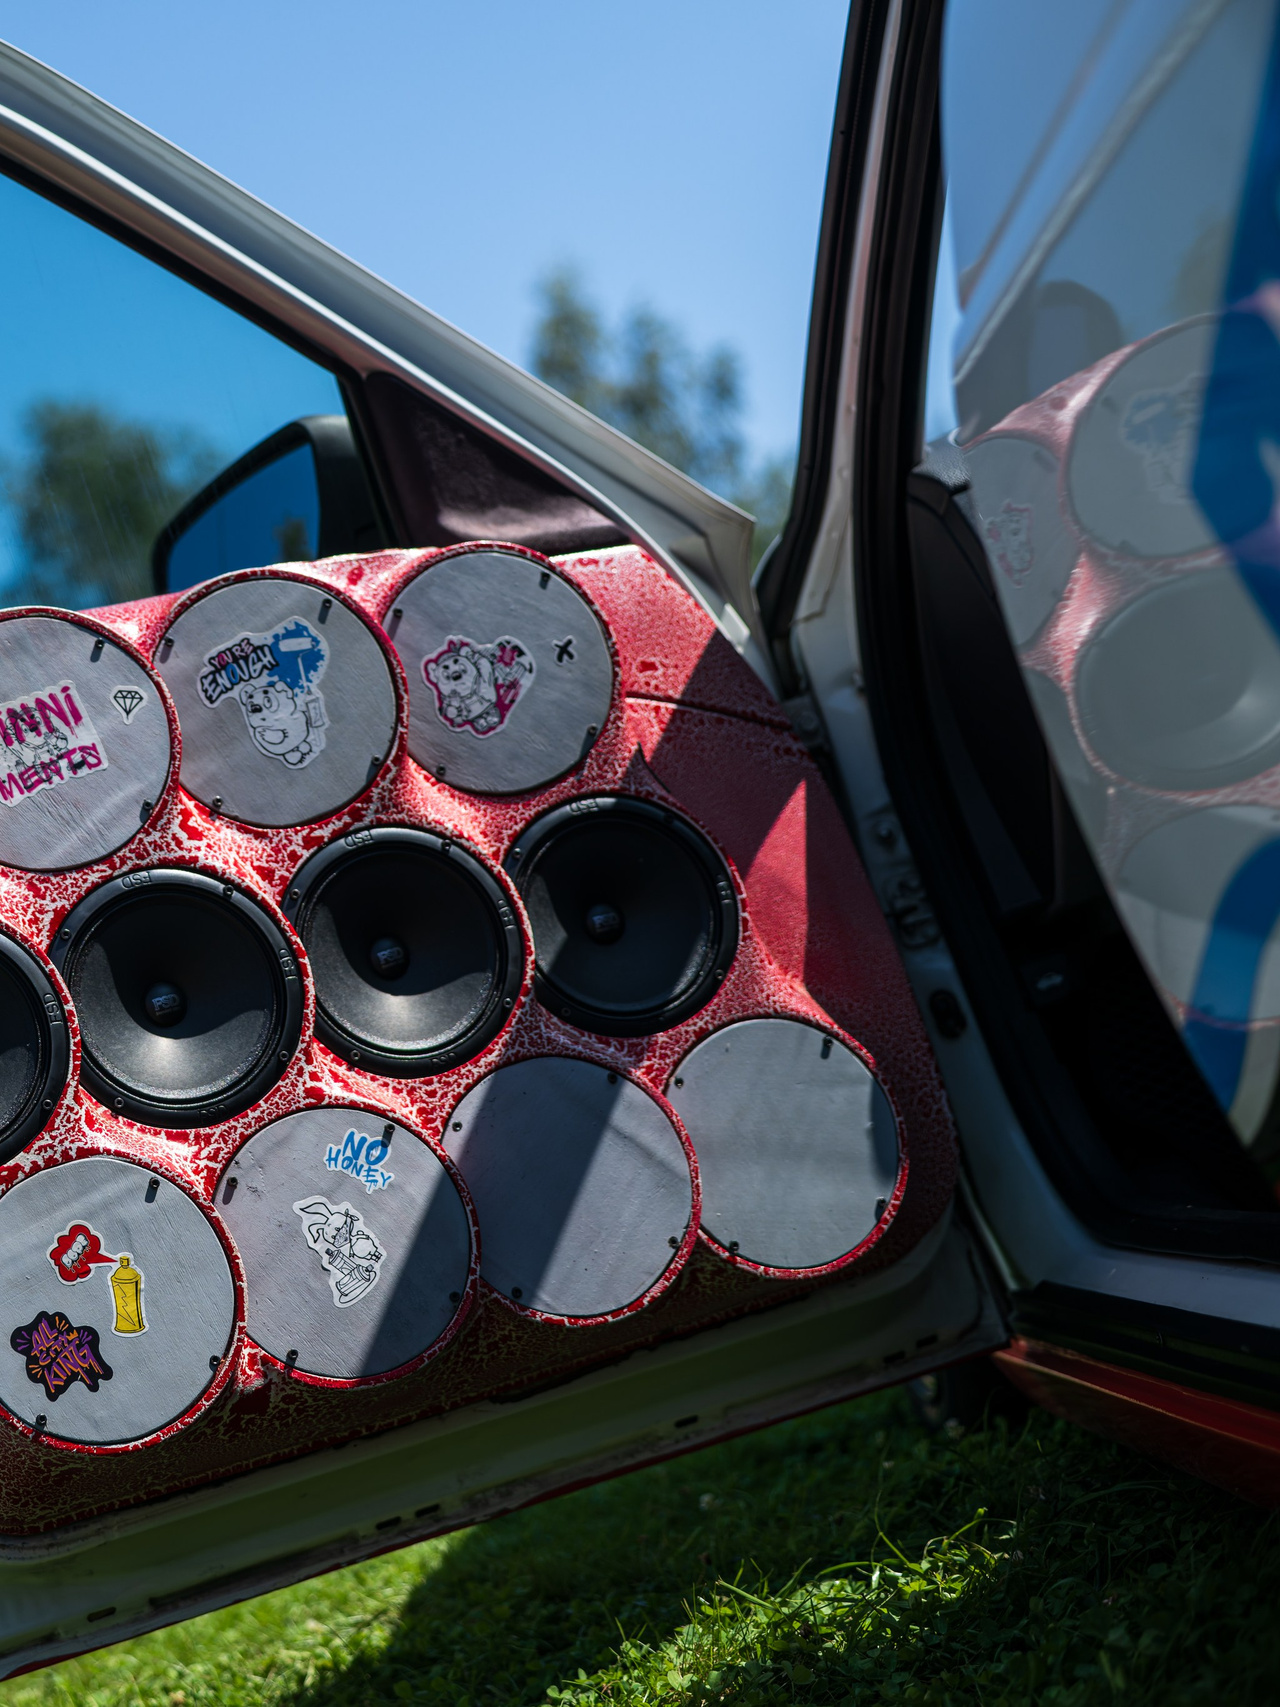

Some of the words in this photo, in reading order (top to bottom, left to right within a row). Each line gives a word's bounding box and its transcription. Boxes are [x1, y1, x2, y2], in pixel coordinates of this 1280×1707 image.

[200, 645, 278, 702] ENOUGH
[344, 830, 374, 848] FSD
[121, 871, 153, 889] FSD
[43, 993, 64, 1026] FSD
[151, 993, 179, 1011] FSD
[343, 1131, 388, 1166] NO
[325, 1146, 392, 1190] HONEY
[61, 1233, 90, 1270] DOPE
[31, 1318, 58, 1357] ALL
[39, 1331, 69, 1366] CITY
[44, 1338, 104, 1393] KING
